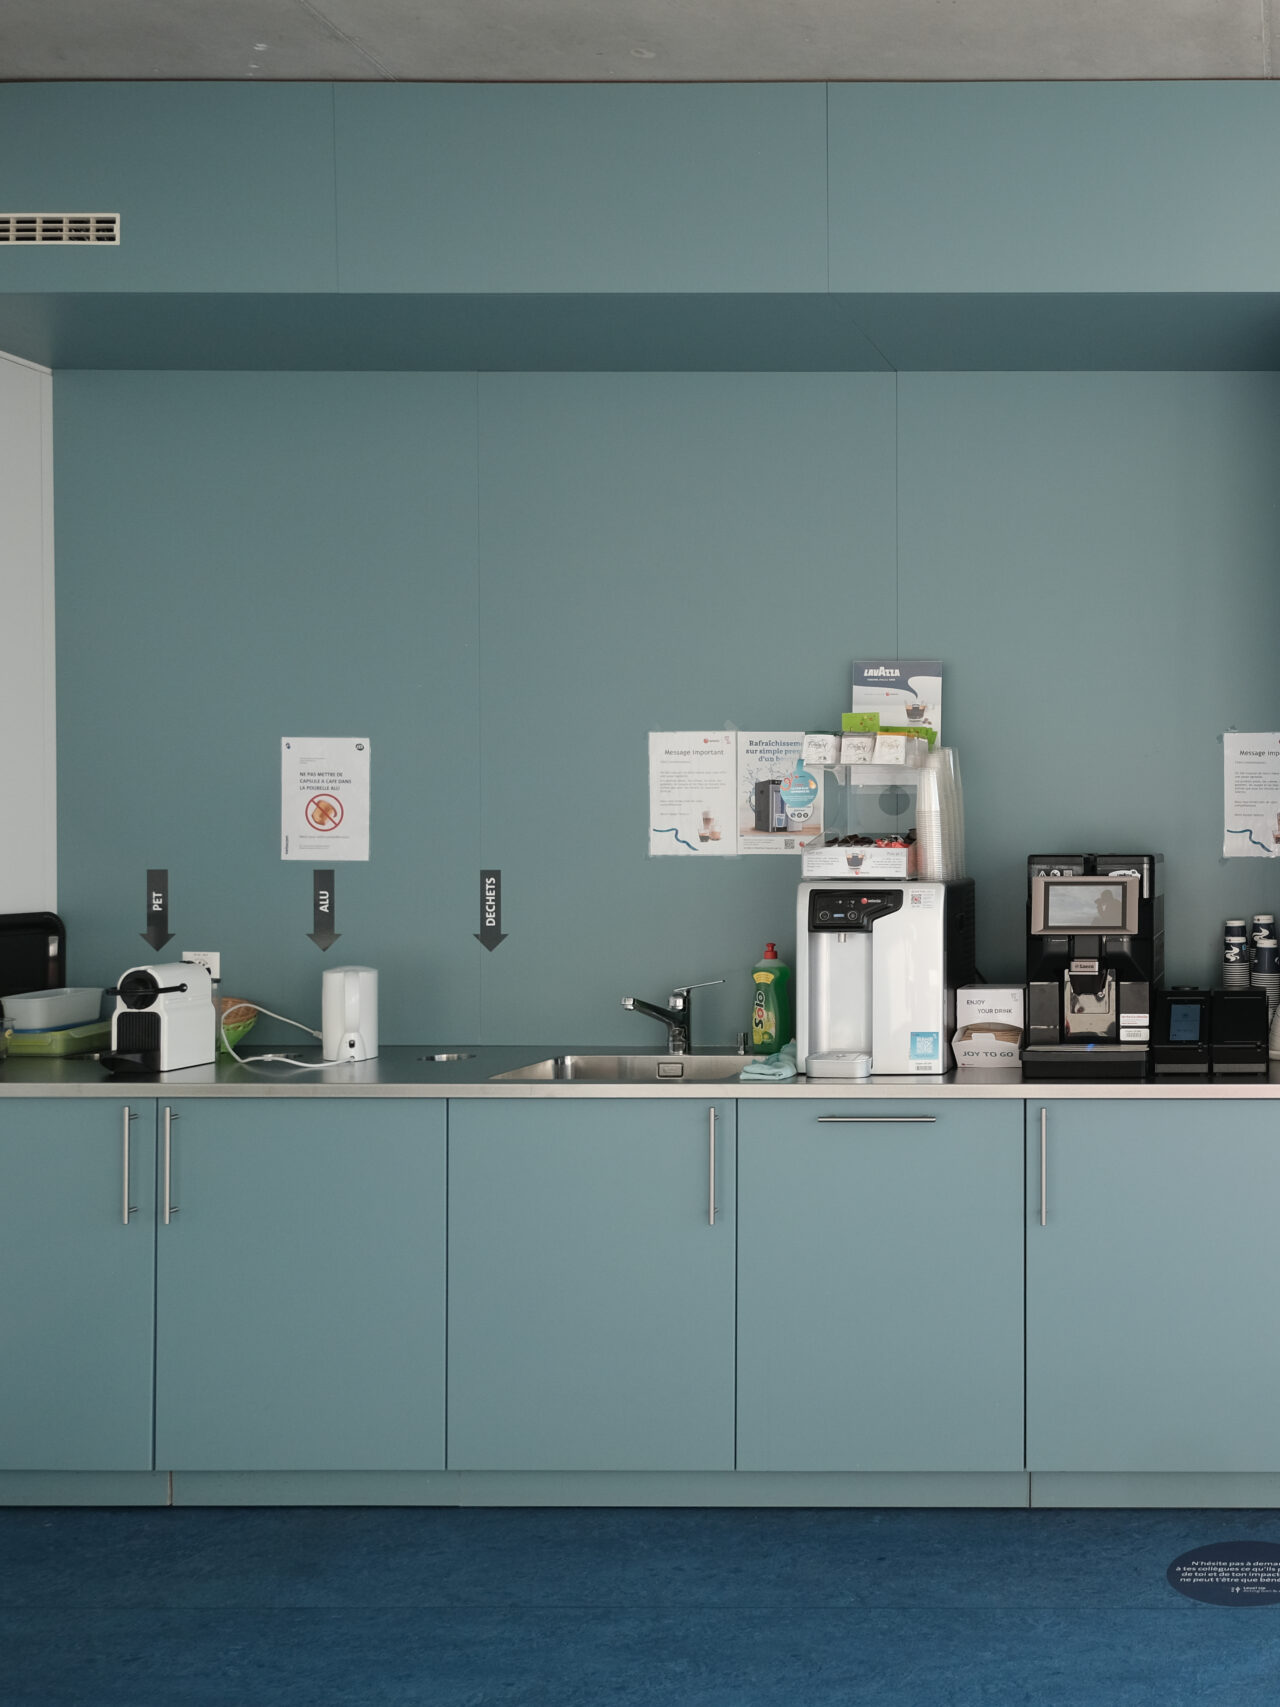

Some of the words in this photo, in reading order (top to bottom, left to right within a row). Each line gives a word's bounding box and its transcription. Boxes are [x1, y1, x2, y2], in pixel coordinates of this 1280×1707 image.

[864, 666, 900, 676] LAVAZZA
[759, 748, 783, 756] simple
[153, 891, 163, 910] PET
[319, 890, 329, 912] ALU
[486, 877, 495, 926] DECHETS
[754, 990, 765, 1029] Solo
